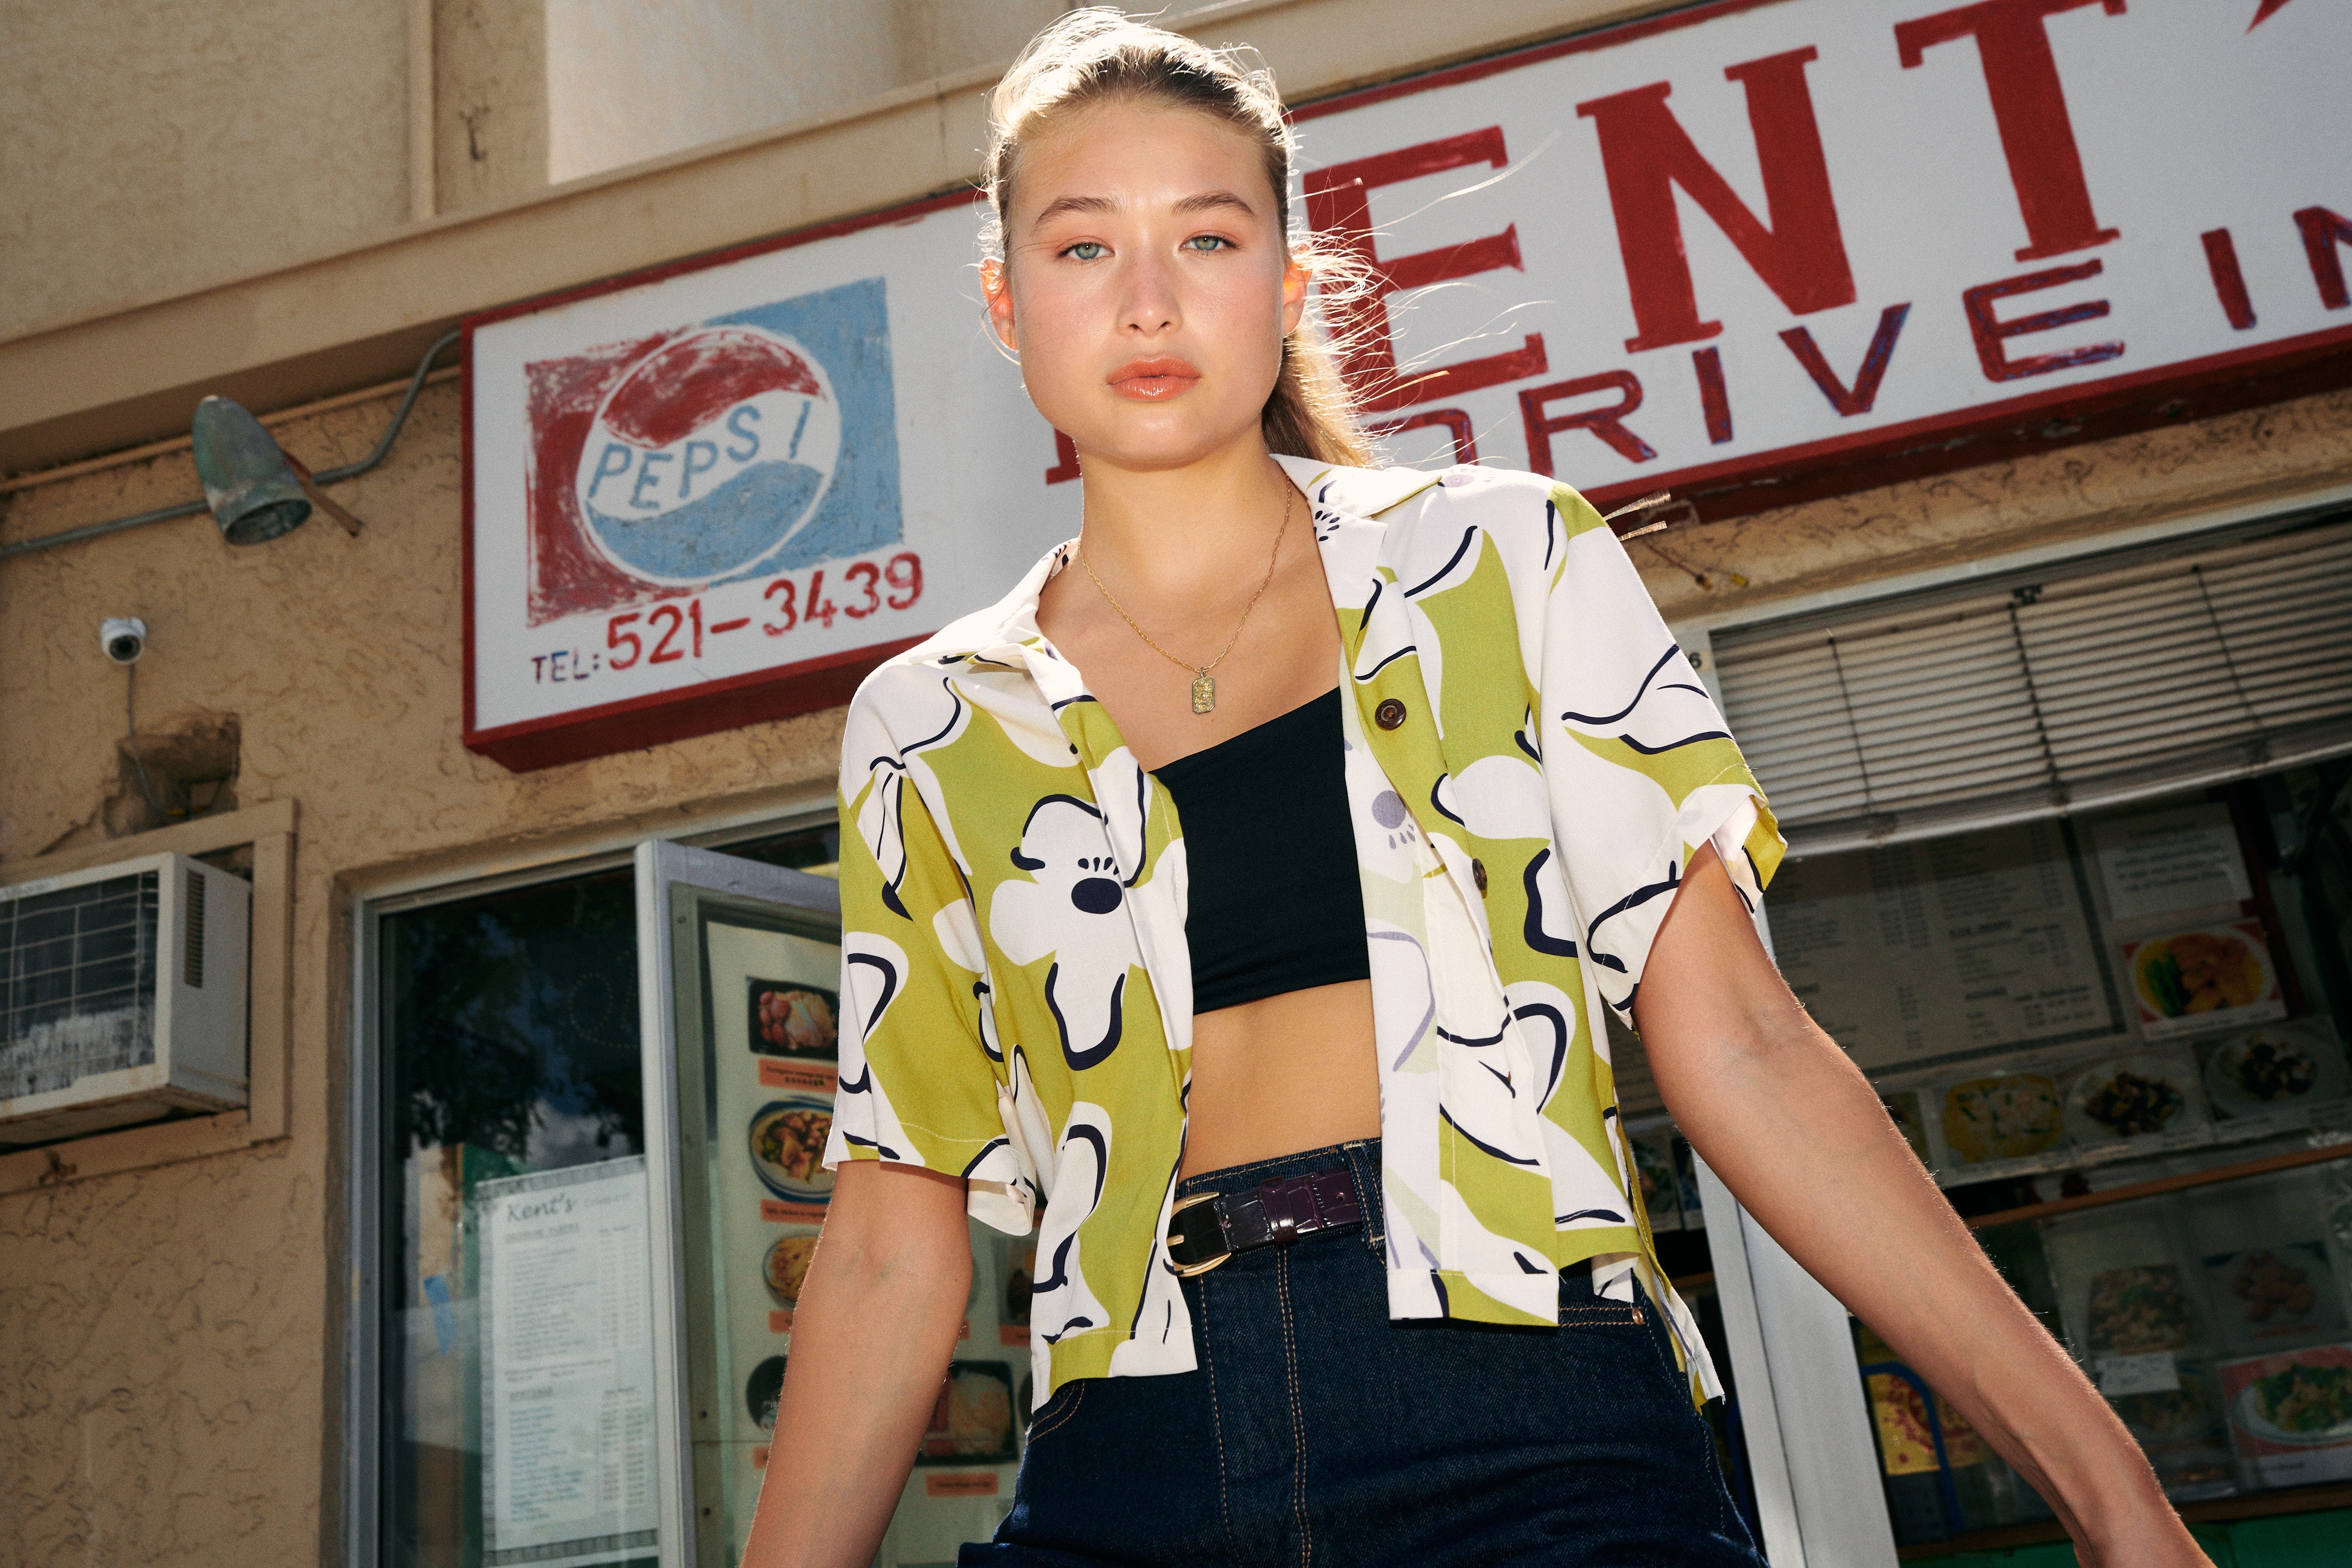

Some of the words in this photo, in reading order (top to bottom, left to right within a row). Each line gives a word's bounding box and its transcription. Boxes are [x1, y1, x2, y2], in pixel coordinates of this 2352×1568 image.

[588, 401, 811, 509] PEPSI
[531, 648, 600, 683] TEL:
[607, 551, 923, 671] 521-3439
